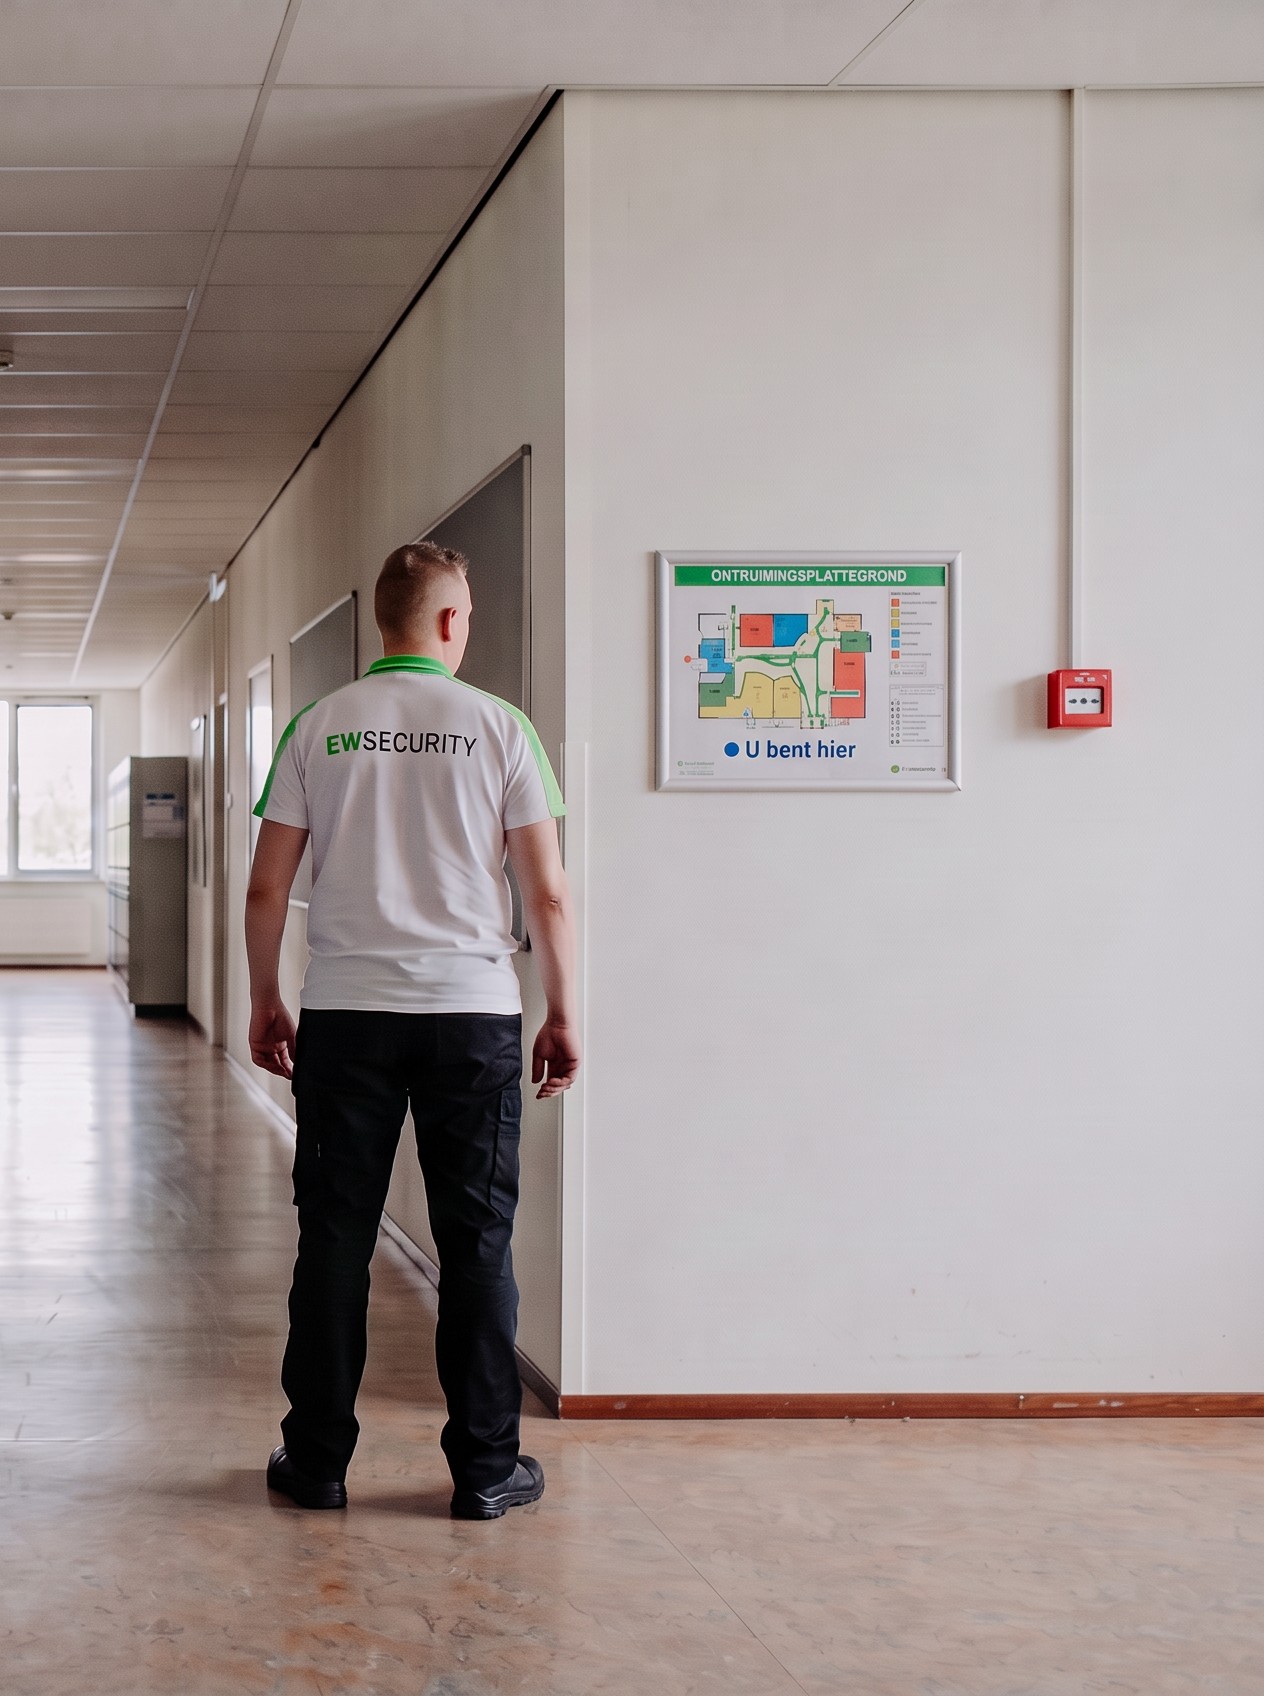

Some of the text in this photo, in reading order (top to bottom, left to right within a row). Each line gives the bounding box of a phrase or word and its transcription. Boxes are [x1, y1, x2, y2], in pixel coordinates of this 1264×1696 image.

[711, 569, 907, 583] ONTRUIMINGSPLATTEGROND
[326, 730, 477, 757] EWSECURITY
[745, 740, 856, 759] U bent hier
